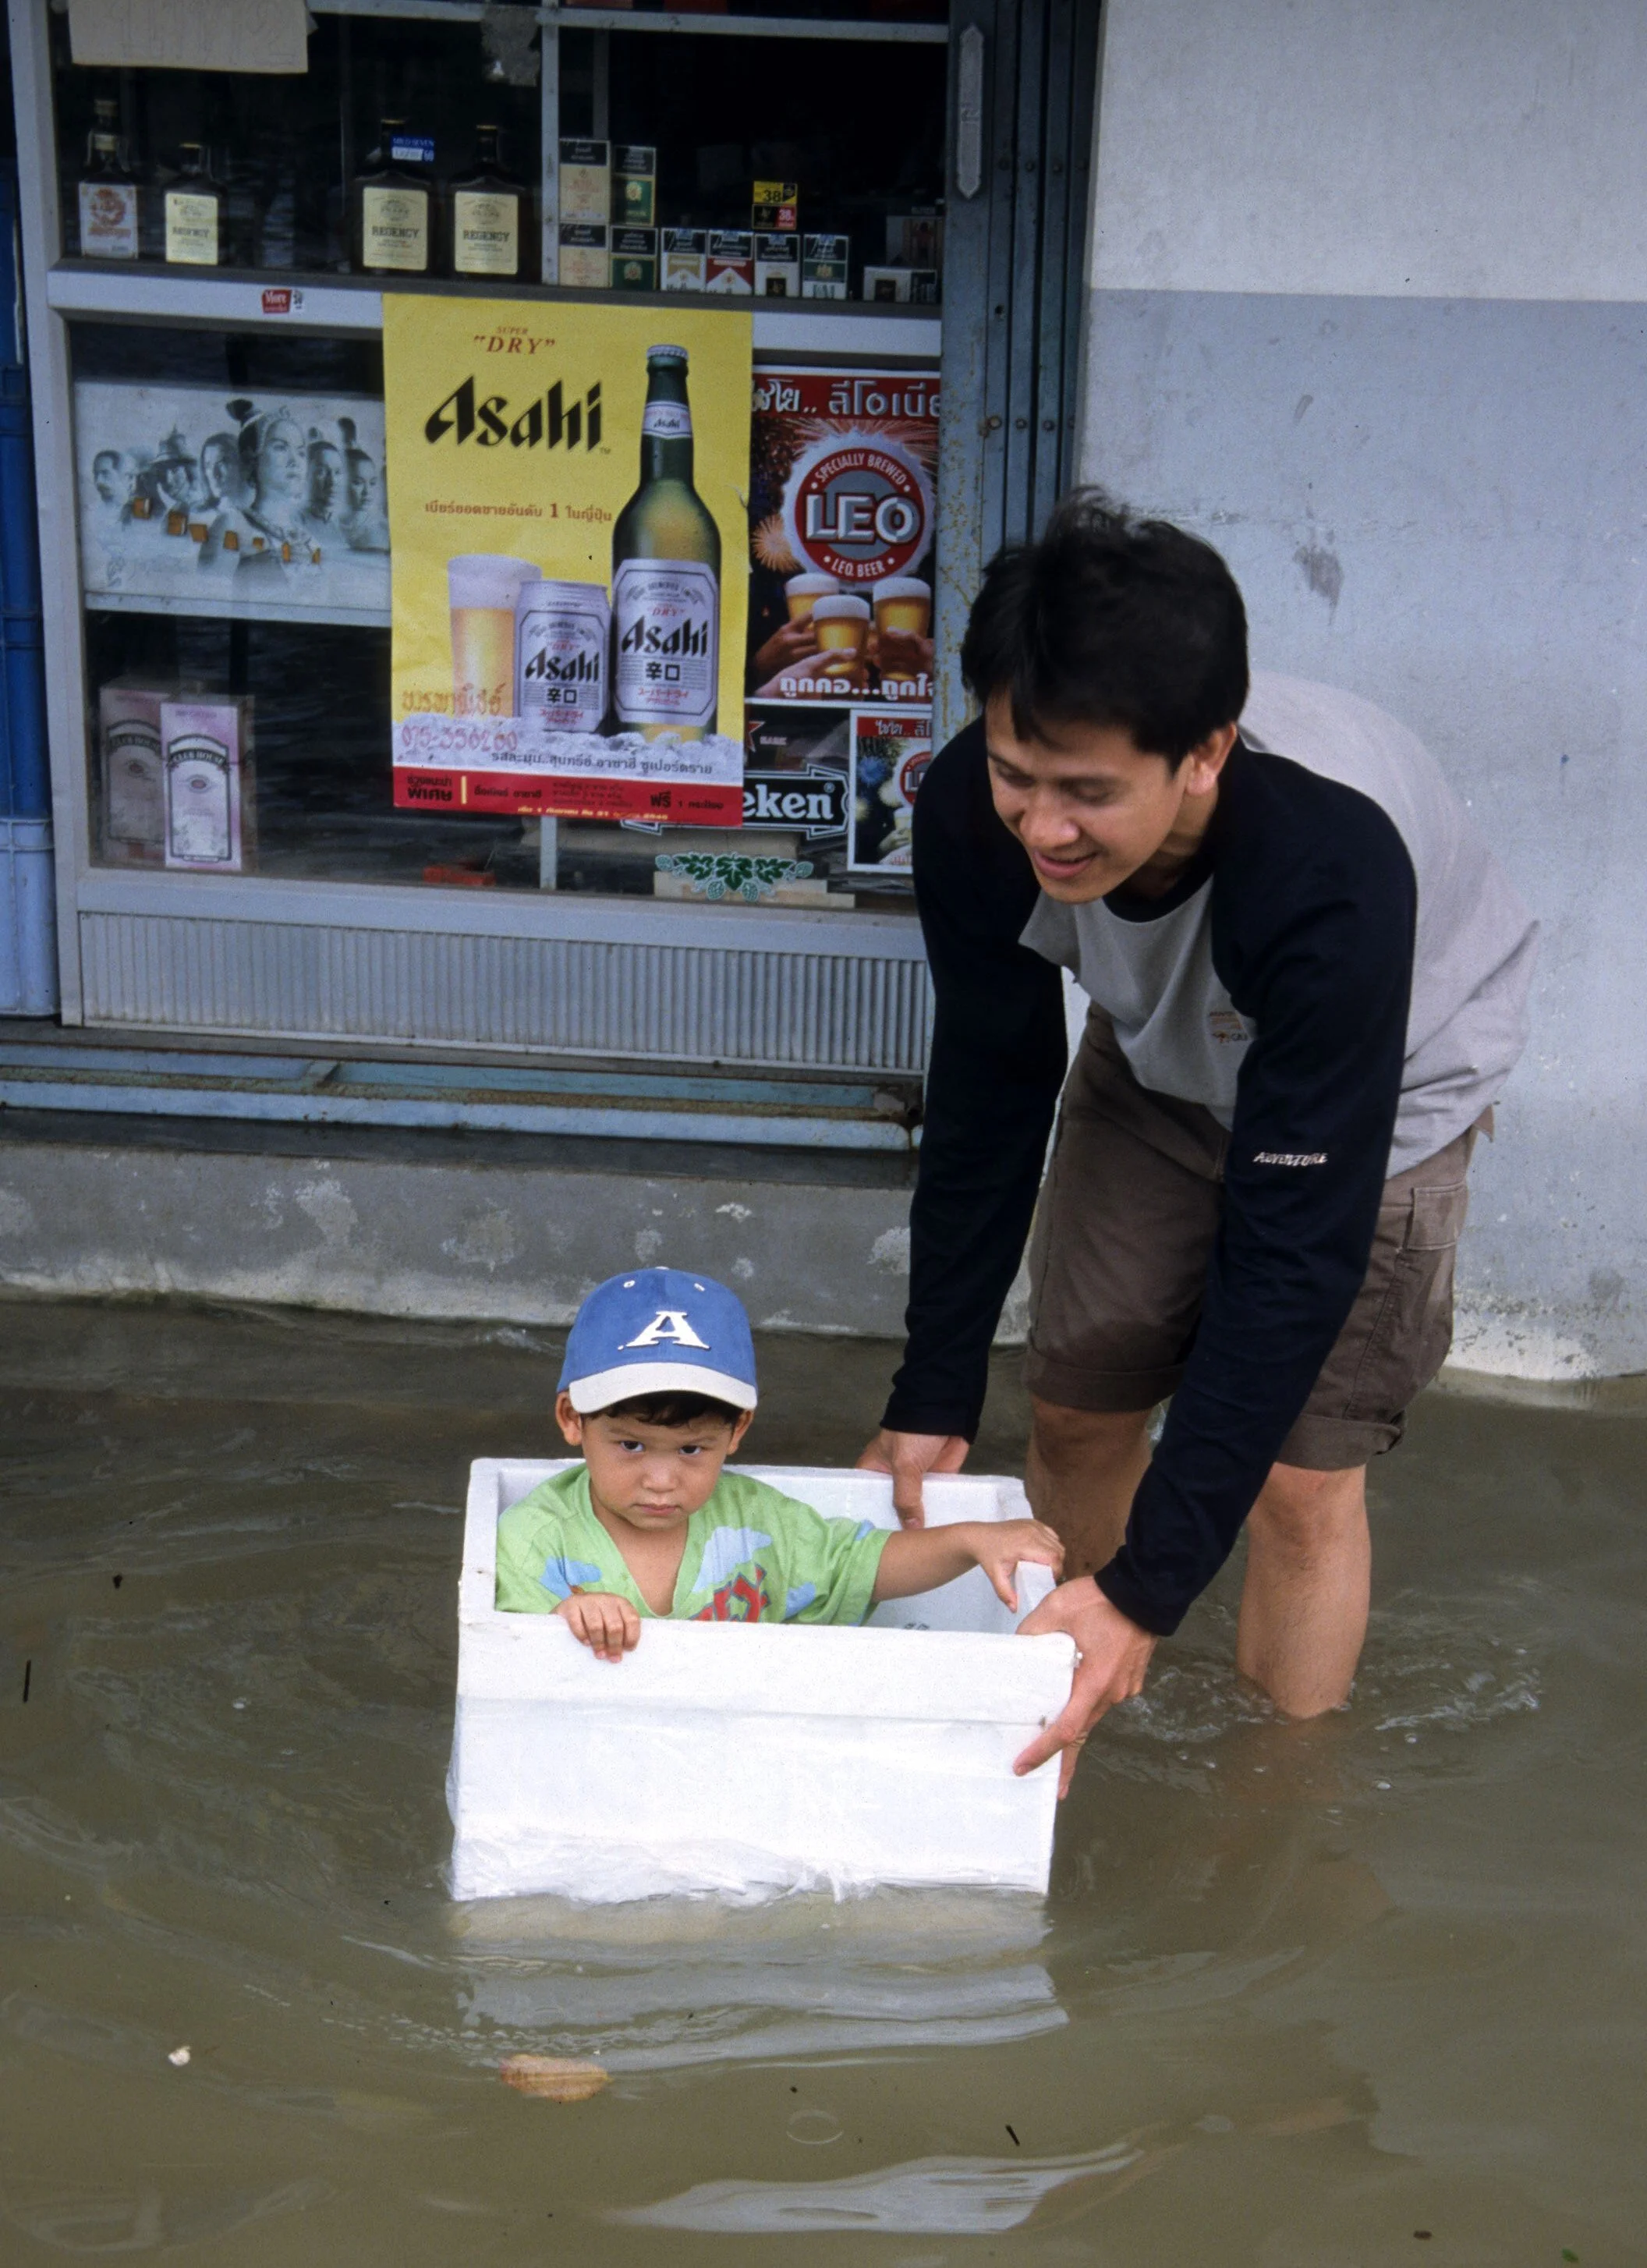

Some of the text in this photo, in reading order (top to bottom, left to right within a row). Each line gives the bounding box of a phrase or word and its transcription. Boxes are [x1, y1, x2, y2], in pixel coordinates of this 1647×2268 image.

[372, 225, 420, 239] REGENCY
[462, 229, 510, 242] REGENCY
[497, 325, 529, 335] SUPER
[424, 374, 602, 452] Asahi
[815, 452, 907, 485] SPECIALLY BREWED
[550, 503, 559, 518] 1
[805, 492, 921, 544] LEO
[857, 560, 887, 578] BEER
[622, 615, 708, 657] Asahi
[525, 647, 600, 682] Asahi
[646, 661, 681, 681] 辛口
[1252, 1151, 1328, 1167] ADVENTURE
[618, 1310, 712, 1352] A
